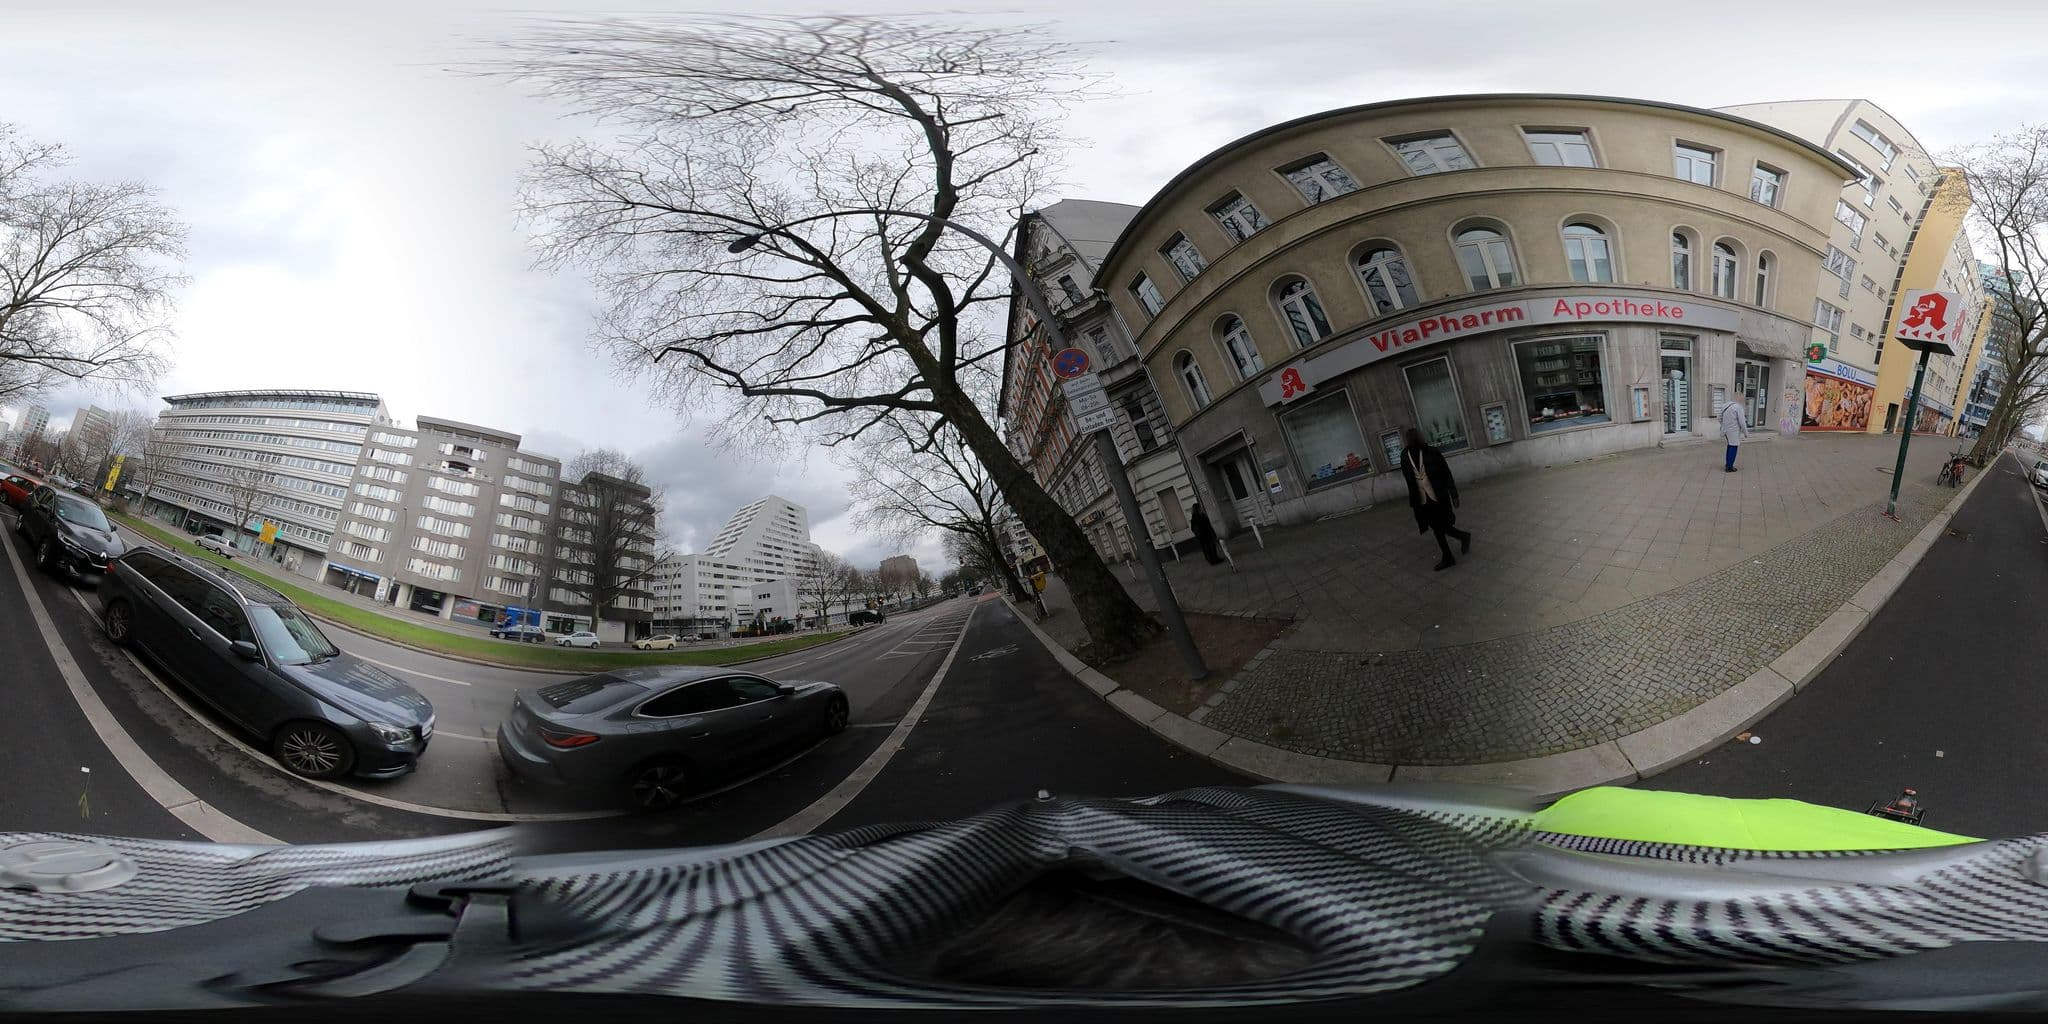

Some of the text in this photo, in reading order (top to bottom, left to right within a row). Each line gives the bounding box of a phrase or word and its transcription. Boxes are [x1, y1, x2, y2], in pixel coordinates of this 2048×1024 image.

[1369, 298, 1684, 352] ViaPharm Apotheke
[1836, 364, 1857, 380] BOLU
